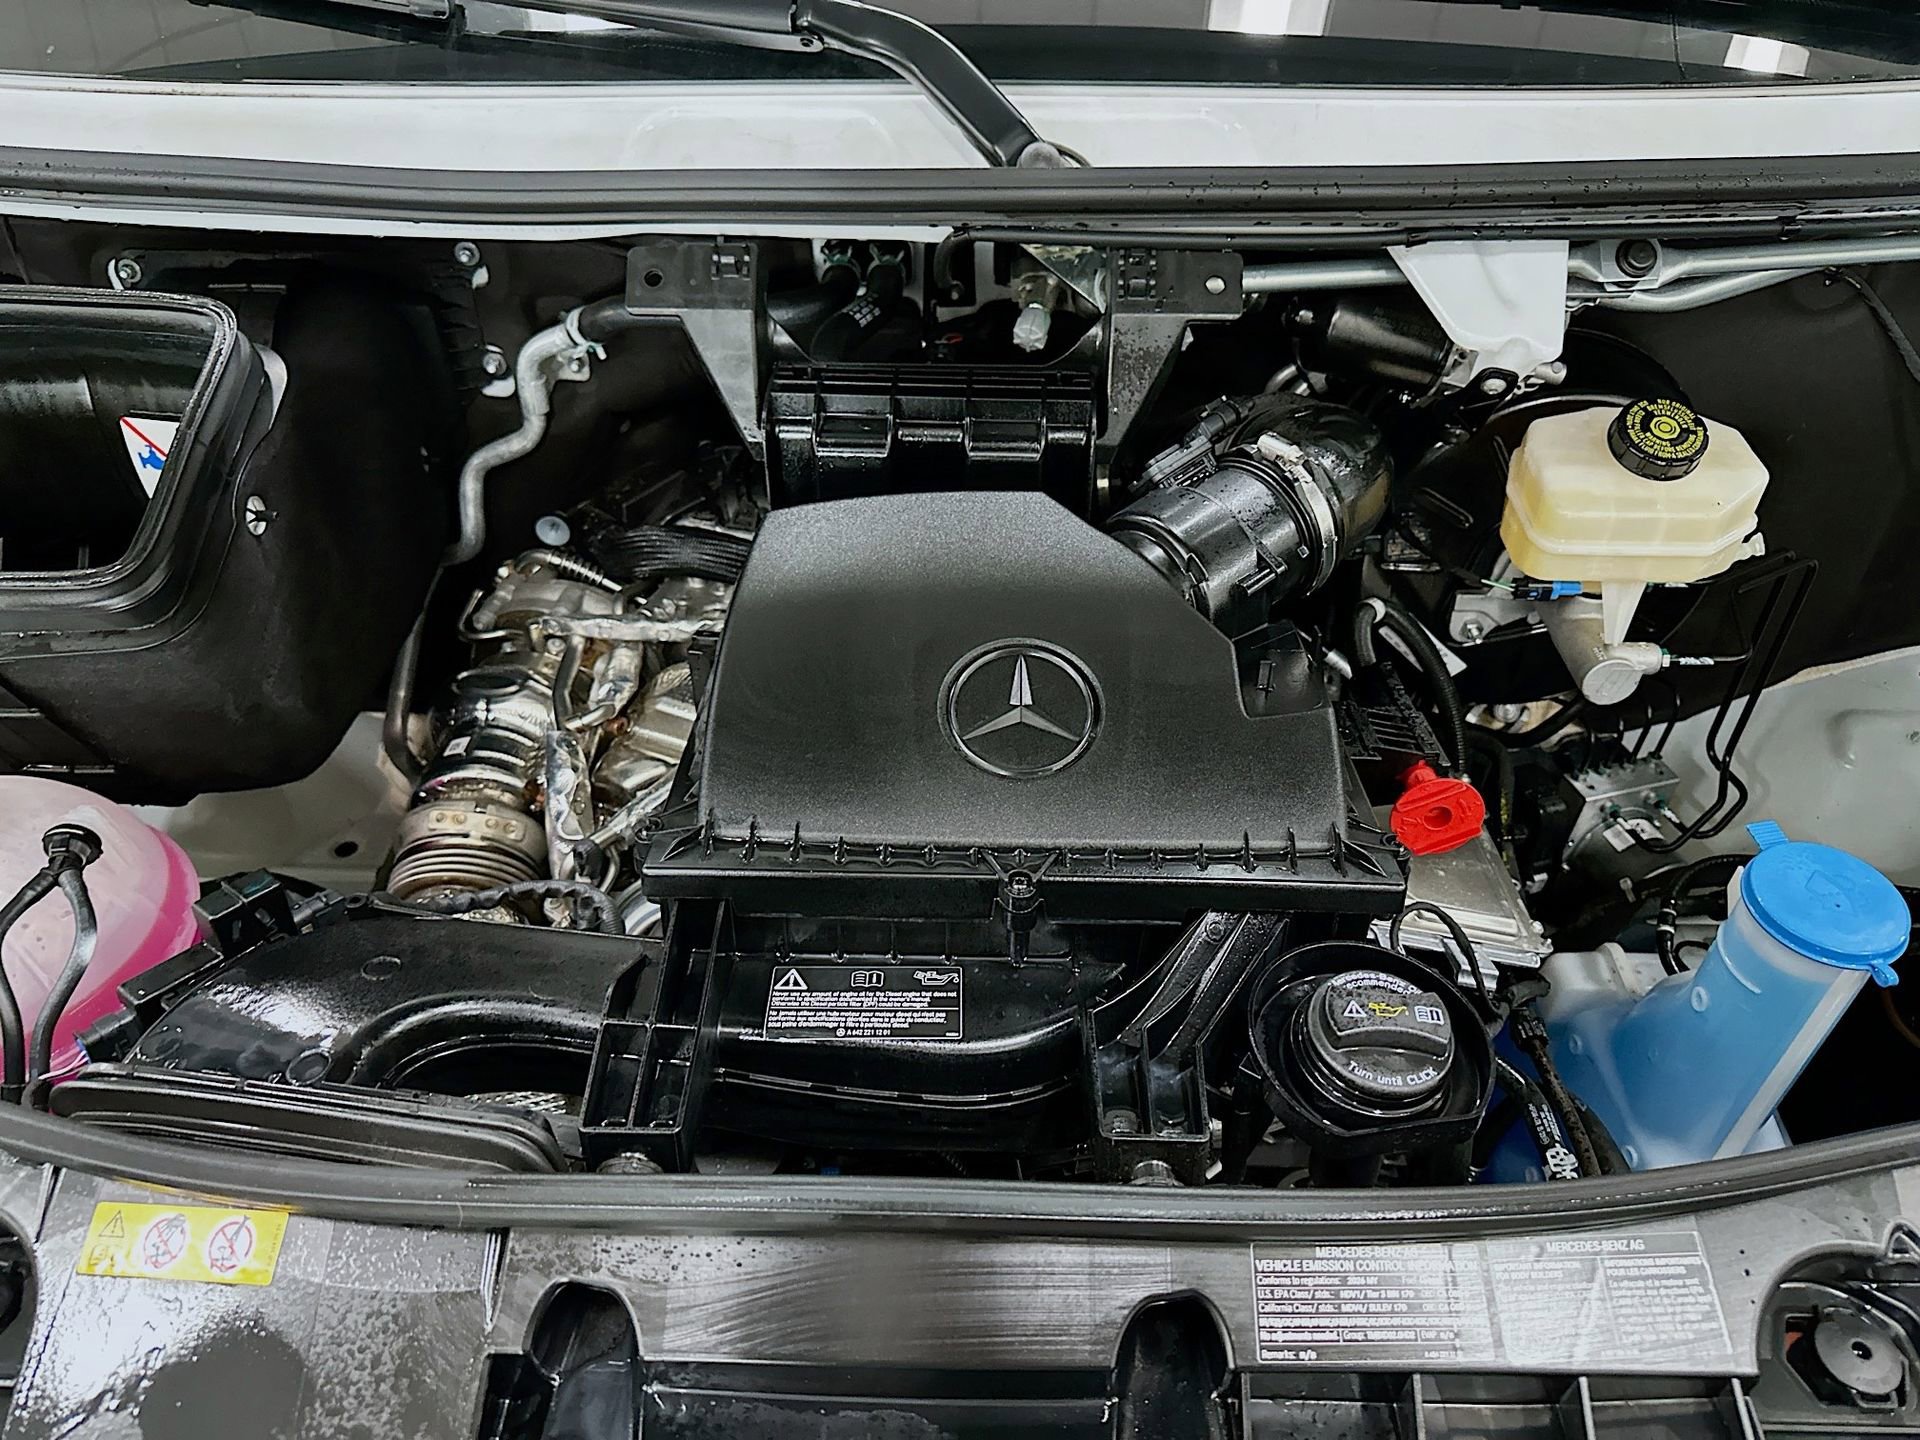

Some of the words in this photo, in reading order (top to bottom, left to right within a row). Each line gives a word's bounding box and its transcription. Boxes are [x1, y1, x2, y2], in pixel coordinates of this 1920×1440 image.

[1348, 1061, 1373, 1080] Turn
[1377, 1076, 1403, 1086] until
[1406, 1067, 1438, 1085] CLICK
[1546, 1241, 1629, 1252] MERCEDES-BENZ
[1630, 1240, 1645, 1250] AG
[1315, 1246, 1403, 1258] MERCEDES-BENZ
[1255, 1260, 1301, 1272] VEHICLE
[1302, 1260, 1354, 1272] EMISSION
[1356, 1260, 1405, 1272] CONTROL
[1257, 1276, 1291, 1285] Conforms
[1292, 1276, 1300, 1285] to
[1301, 1277, 1342, 1286] regulations:
[1258, 1290, 1273, 1299] U.S.
[1274, 1290, 1289, 1299] EPA
[1259, 1303, 1292, 1312] California
[1261, 1350, 1297, 1360] Remarks:
[1299, 1350, 1317, 1360] n/a
